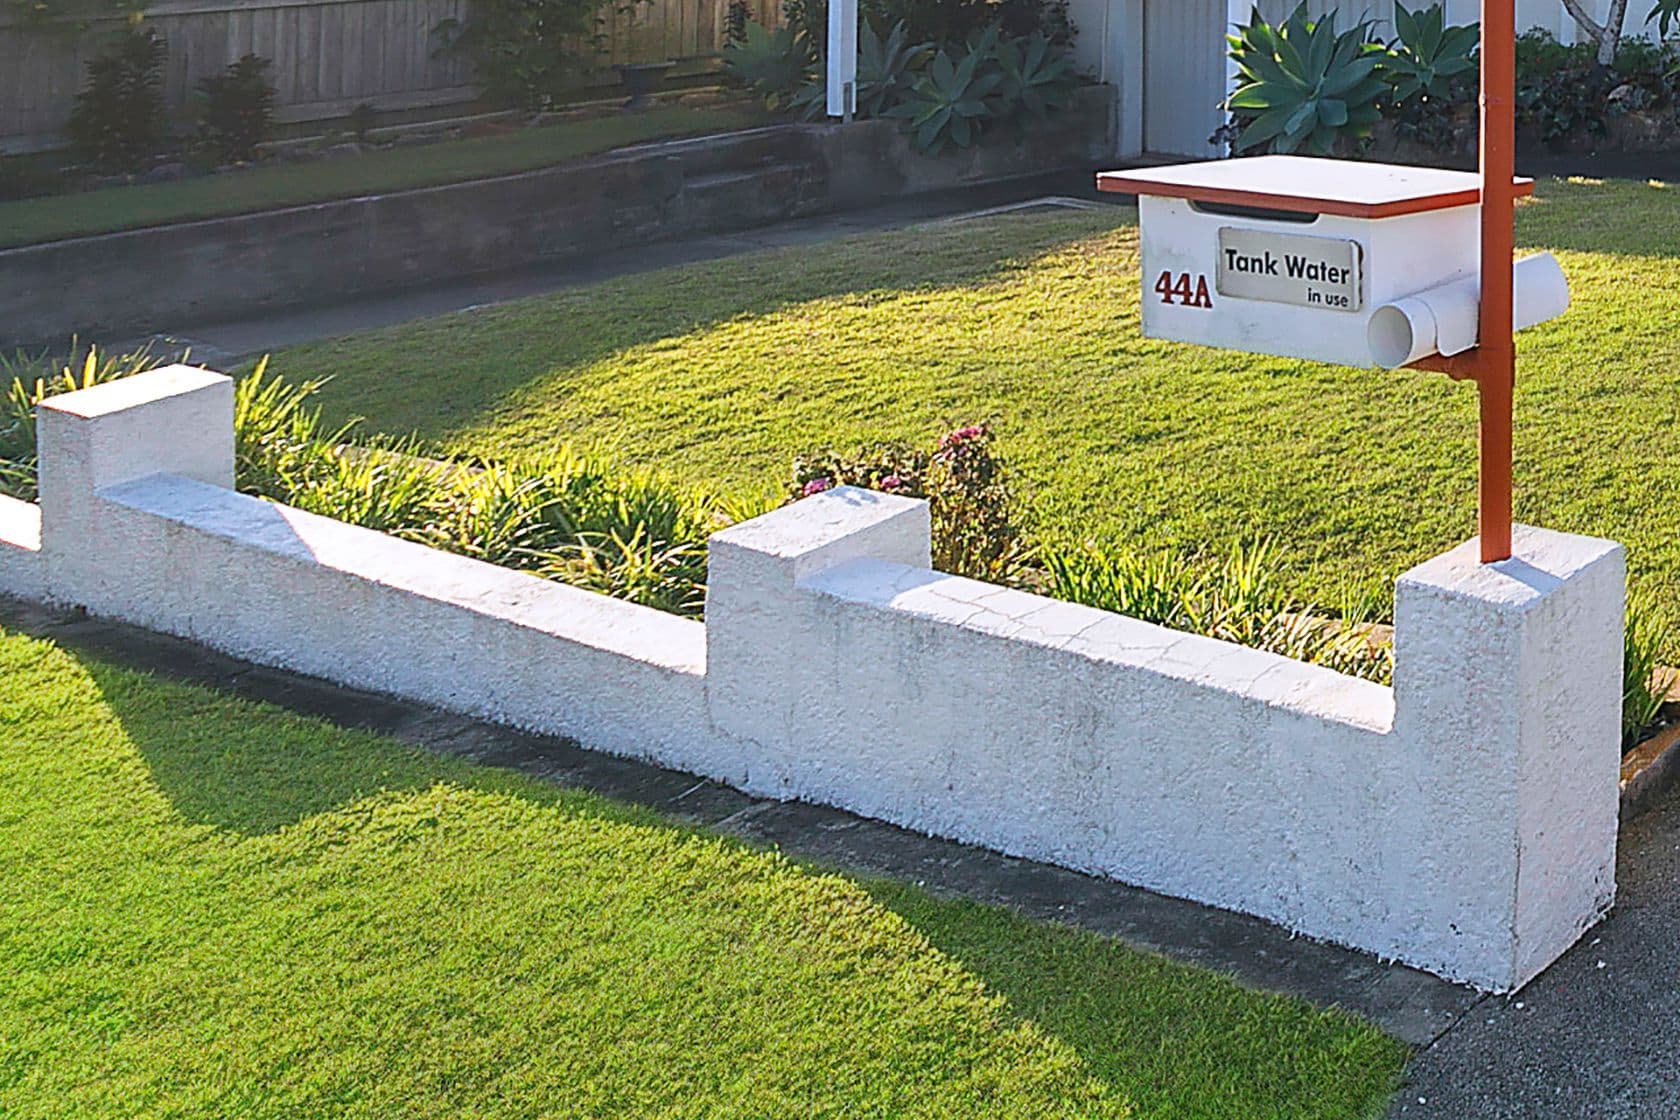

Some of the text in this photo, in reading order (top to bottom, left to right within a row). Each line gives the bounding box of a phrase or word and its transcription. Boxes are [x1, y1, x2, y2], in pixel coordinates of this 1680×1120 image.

[1225, 248, 1350, 286] Tank Water
[1155, 271, 1213, 309] 44A
[1307, 287, 1349, 308] in use
